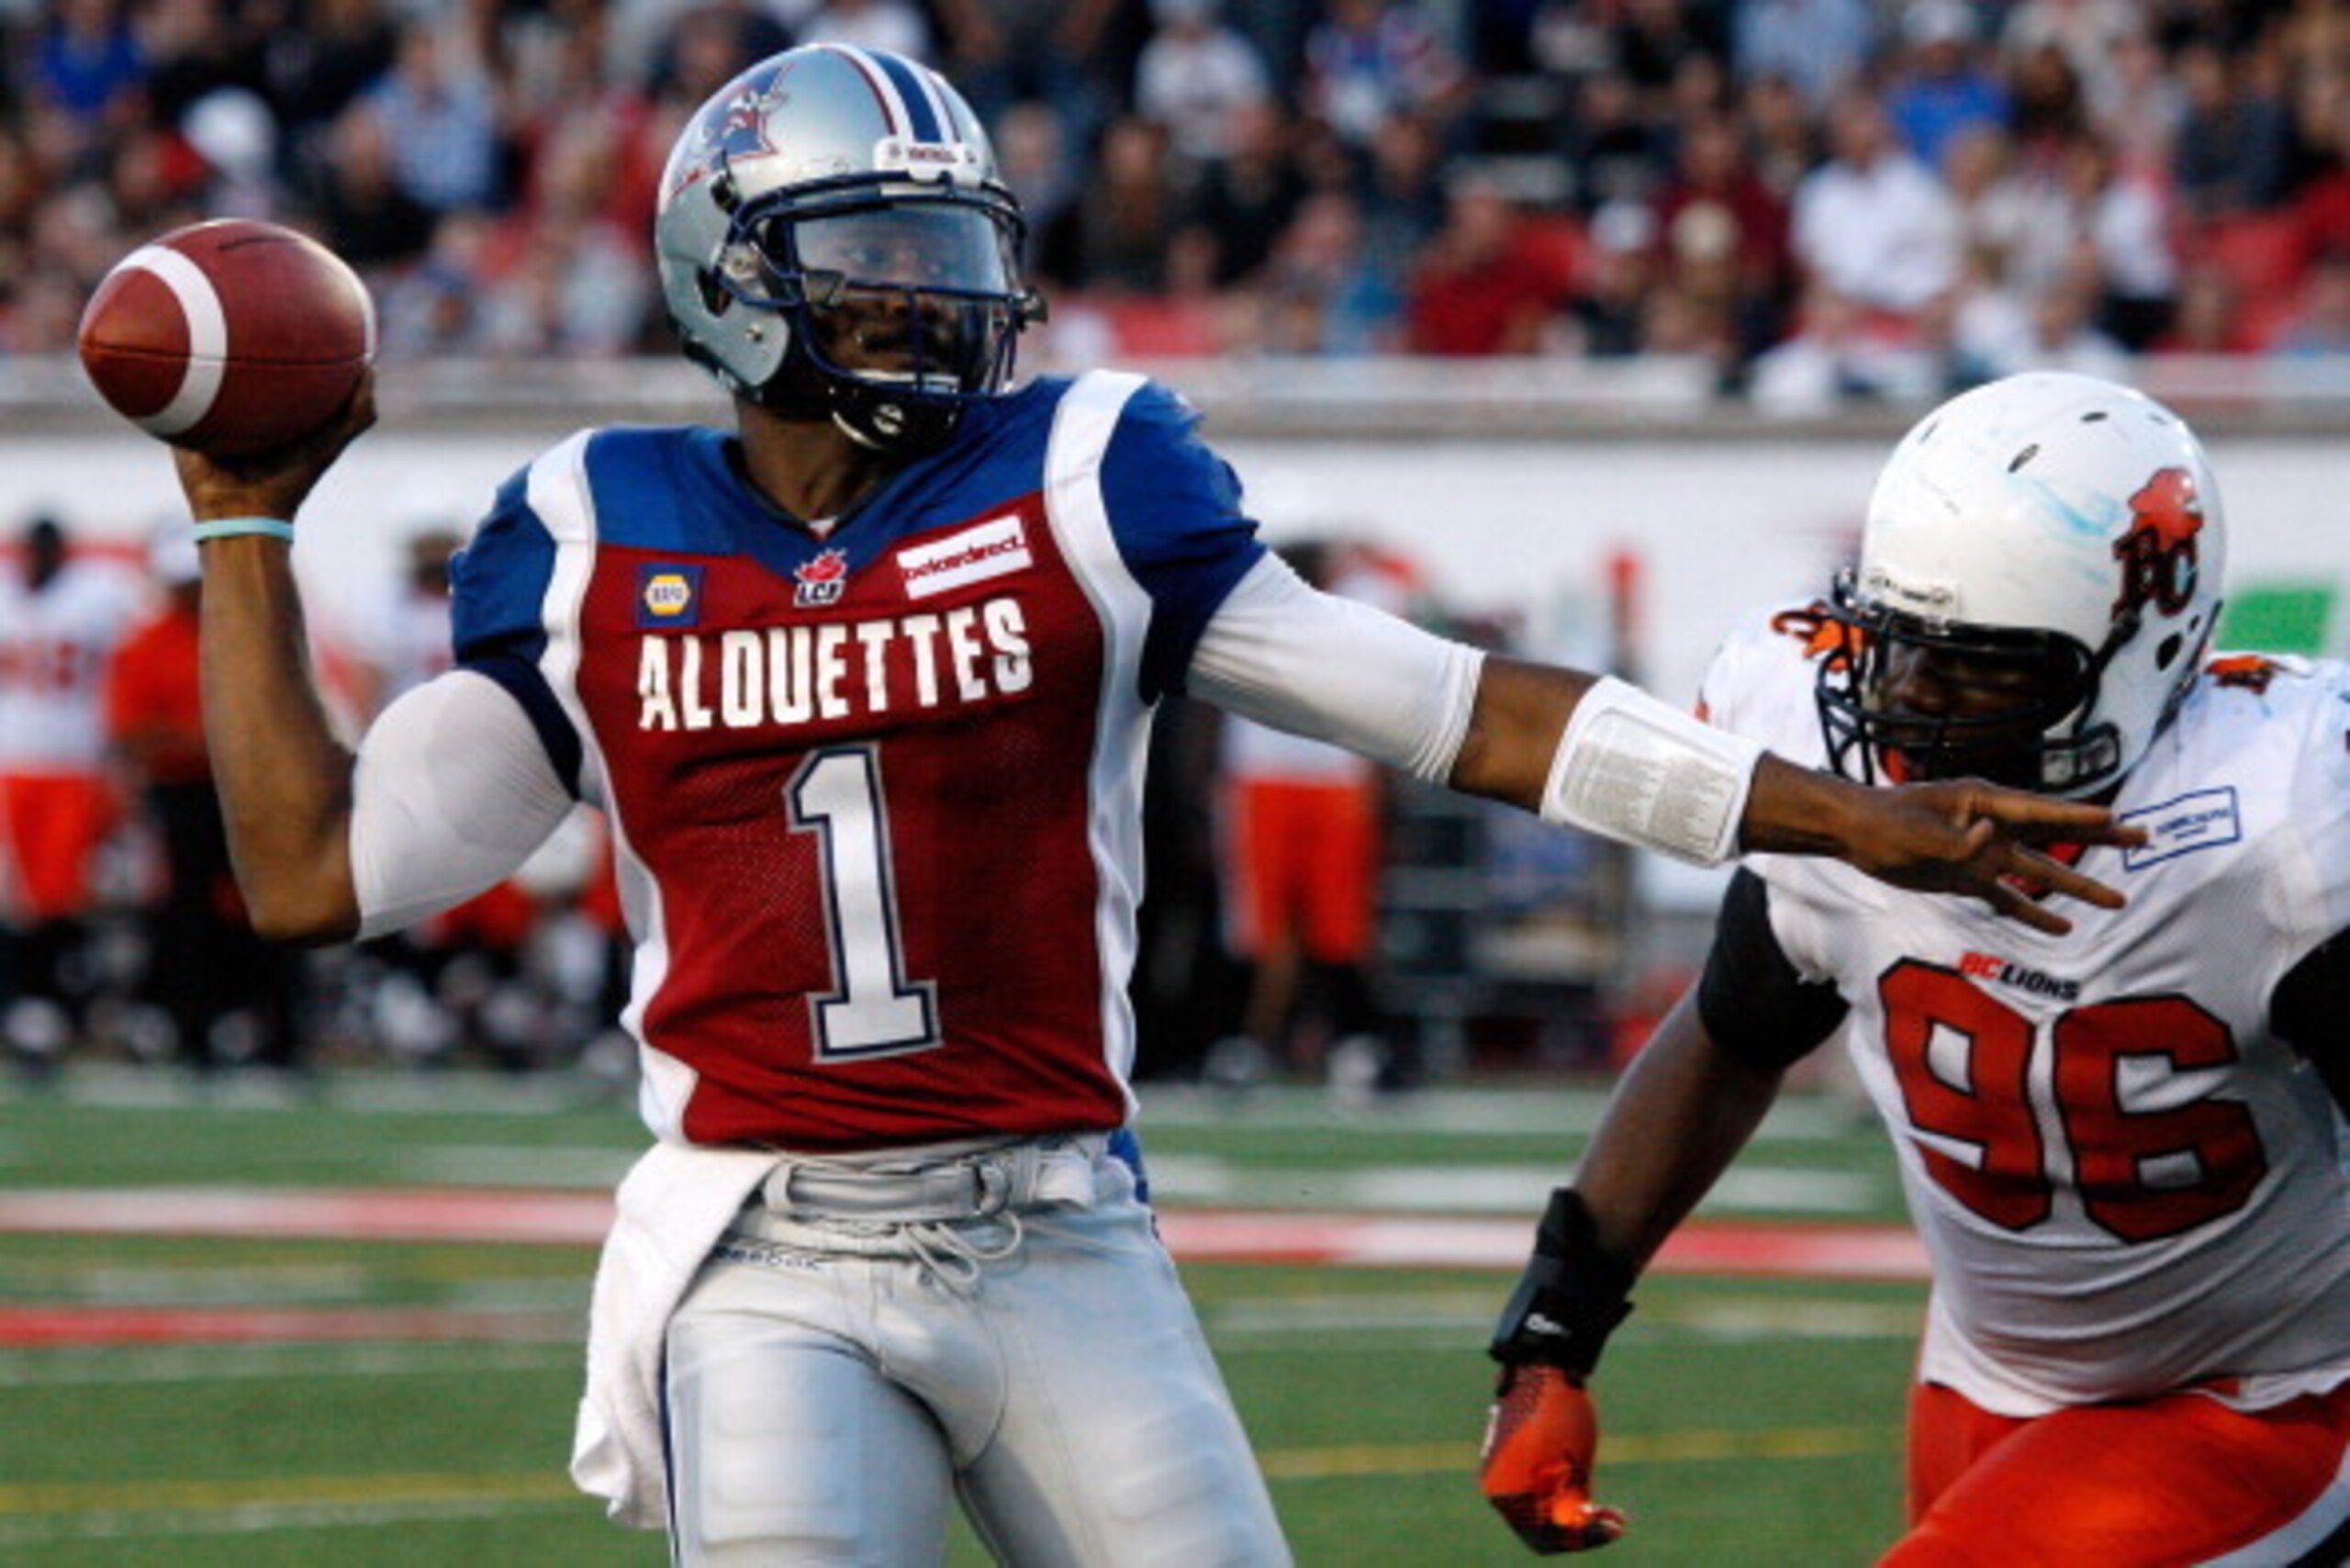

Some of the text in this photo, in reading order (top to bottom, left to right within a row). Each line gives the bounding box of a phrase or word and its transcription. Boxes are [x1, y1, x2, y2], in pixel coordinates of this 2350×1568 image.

[638, 599, 1033, 732] ALOUETTES
[795, 580, 845, 607] LCF
[782, 741, 944, 1065] 1
[1877, 957, 2268, 1245] 96
